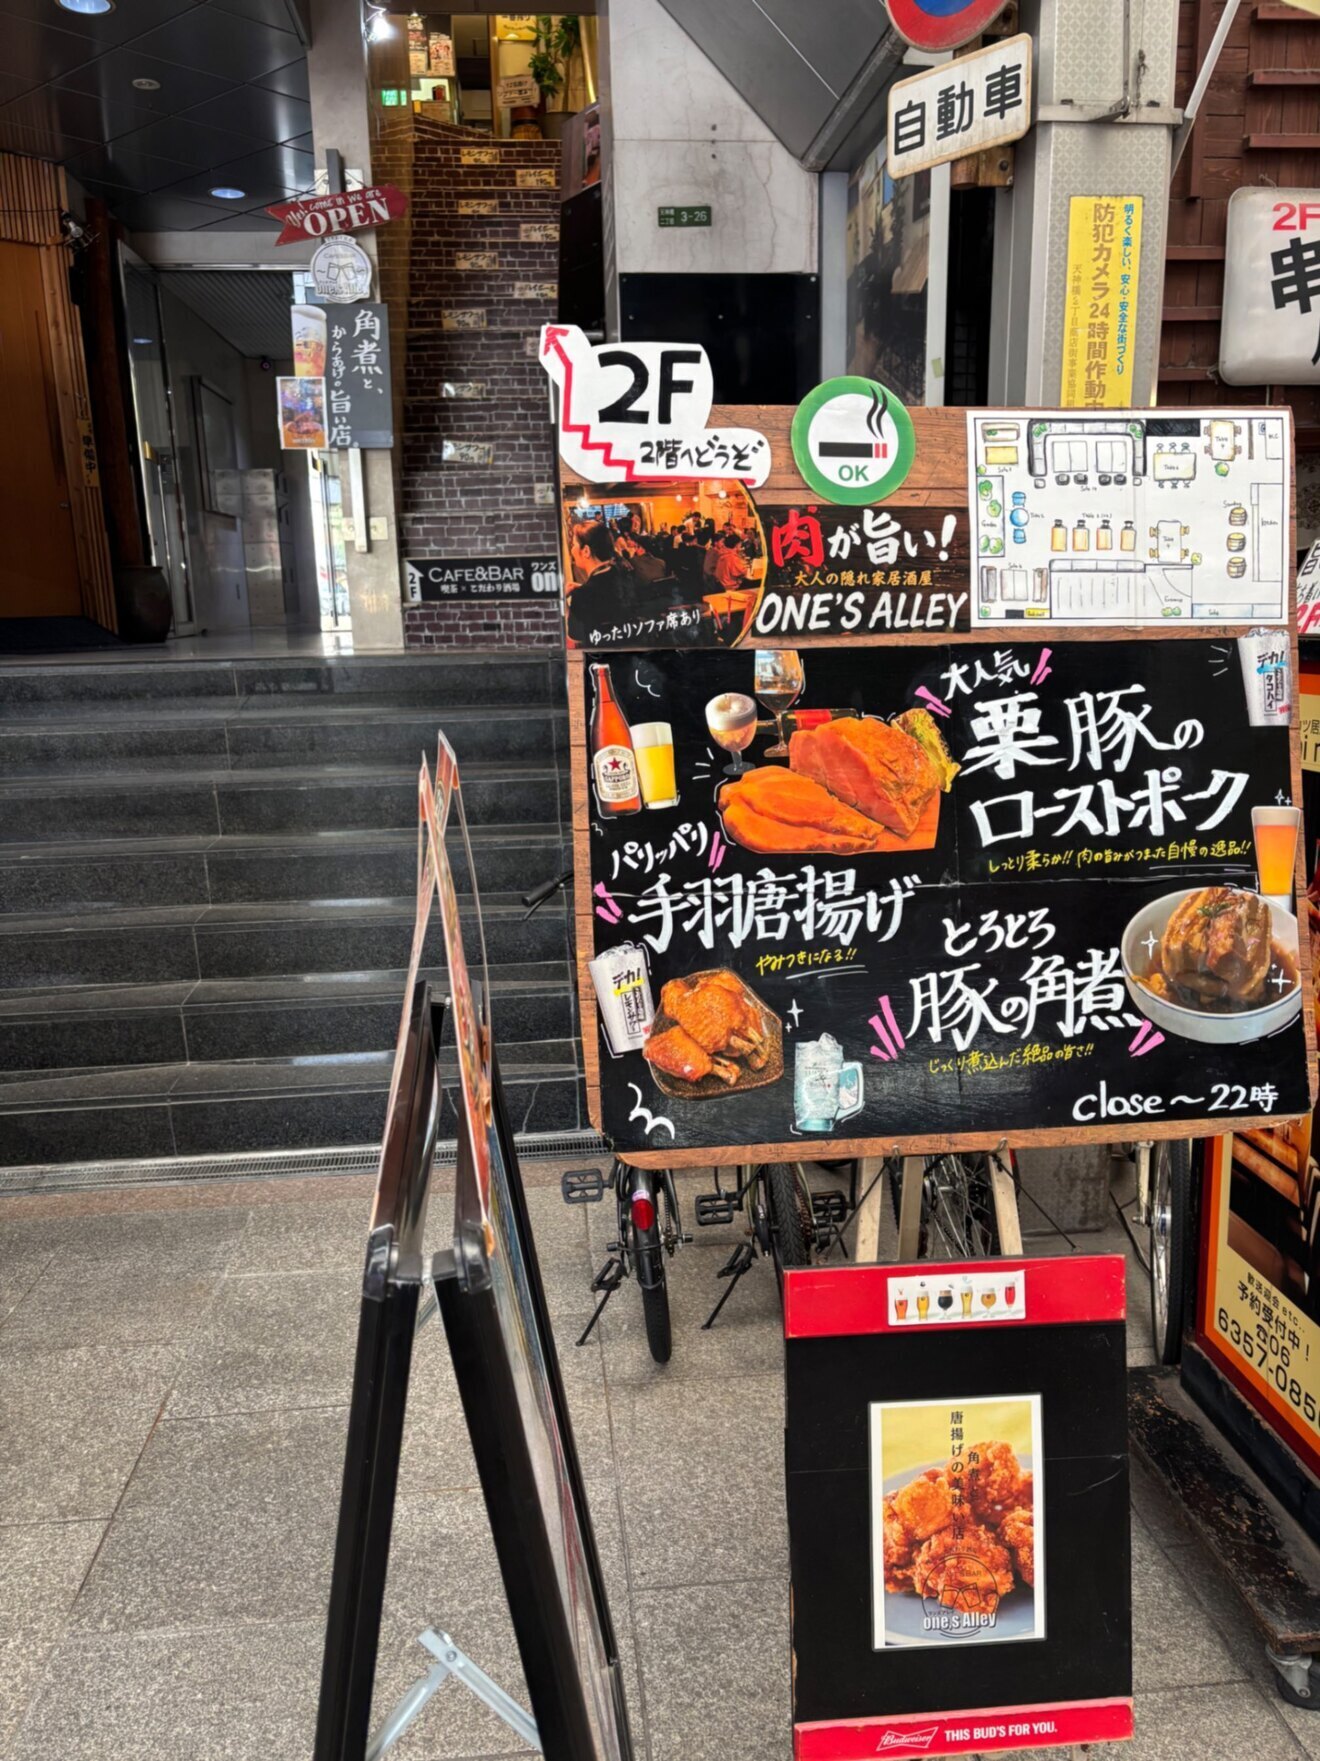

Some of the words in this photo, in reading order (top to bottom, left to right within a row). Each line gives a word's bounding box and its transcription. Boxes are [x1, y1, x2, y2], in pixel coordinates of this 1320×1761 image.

[894, 63, 1023, 156] 自動車
[303, 197, 390, 236] OPEN
[680, 211, 708, 222] 3-26
[1272, 202, 1320, 231] 2F
[1271, 236, 1320, 314] 串
[350, 309, 384, 395] 角煮と、
[597, 350, 702, 424] 2F
[639, 434, 765, 471] 2階へどうぞ
[838, 464, 870, 482] OK
[531, 561, 556, 570] ワンズ
[795, 572, 933, 587] 大人の隠れ家居酒屋
[589, 608, 700, 645] ゆったりソファ席あり
[755, 592, 864, 634] ONE'S
[868, 592, 969, 630] ALLEY
[940, 650, 1030, 700] 大人気
[1266, 675, 1275, 709] タコハイ
[960, 684, 1204, 780] 栗豚の
[970, 767, 1249, 847] ローストポーク
[611, 821, 708, 879] パリッパリ
[628, 865, 921, 954] 手羽唐揚げ
[943, 907, 1056, 957] とろとろ
[906, 948, 1147, 1052] 豚の角煮
[1218, 1308, 1320, 1432] 6357-085
[950, 1411, 964, 1540] 唐揚げの美味い店
[962, 1611, 996, 1628] Alley
[883, 1734, 932, 1746] Budweiser
[945, 1729, 970, 1742] THIS
[973, 1726, 1005, 1739] BUD'S
[1008, 1724, 1030, 1736] FOR
[1032, 1721, 1057, 1734] YOU.
